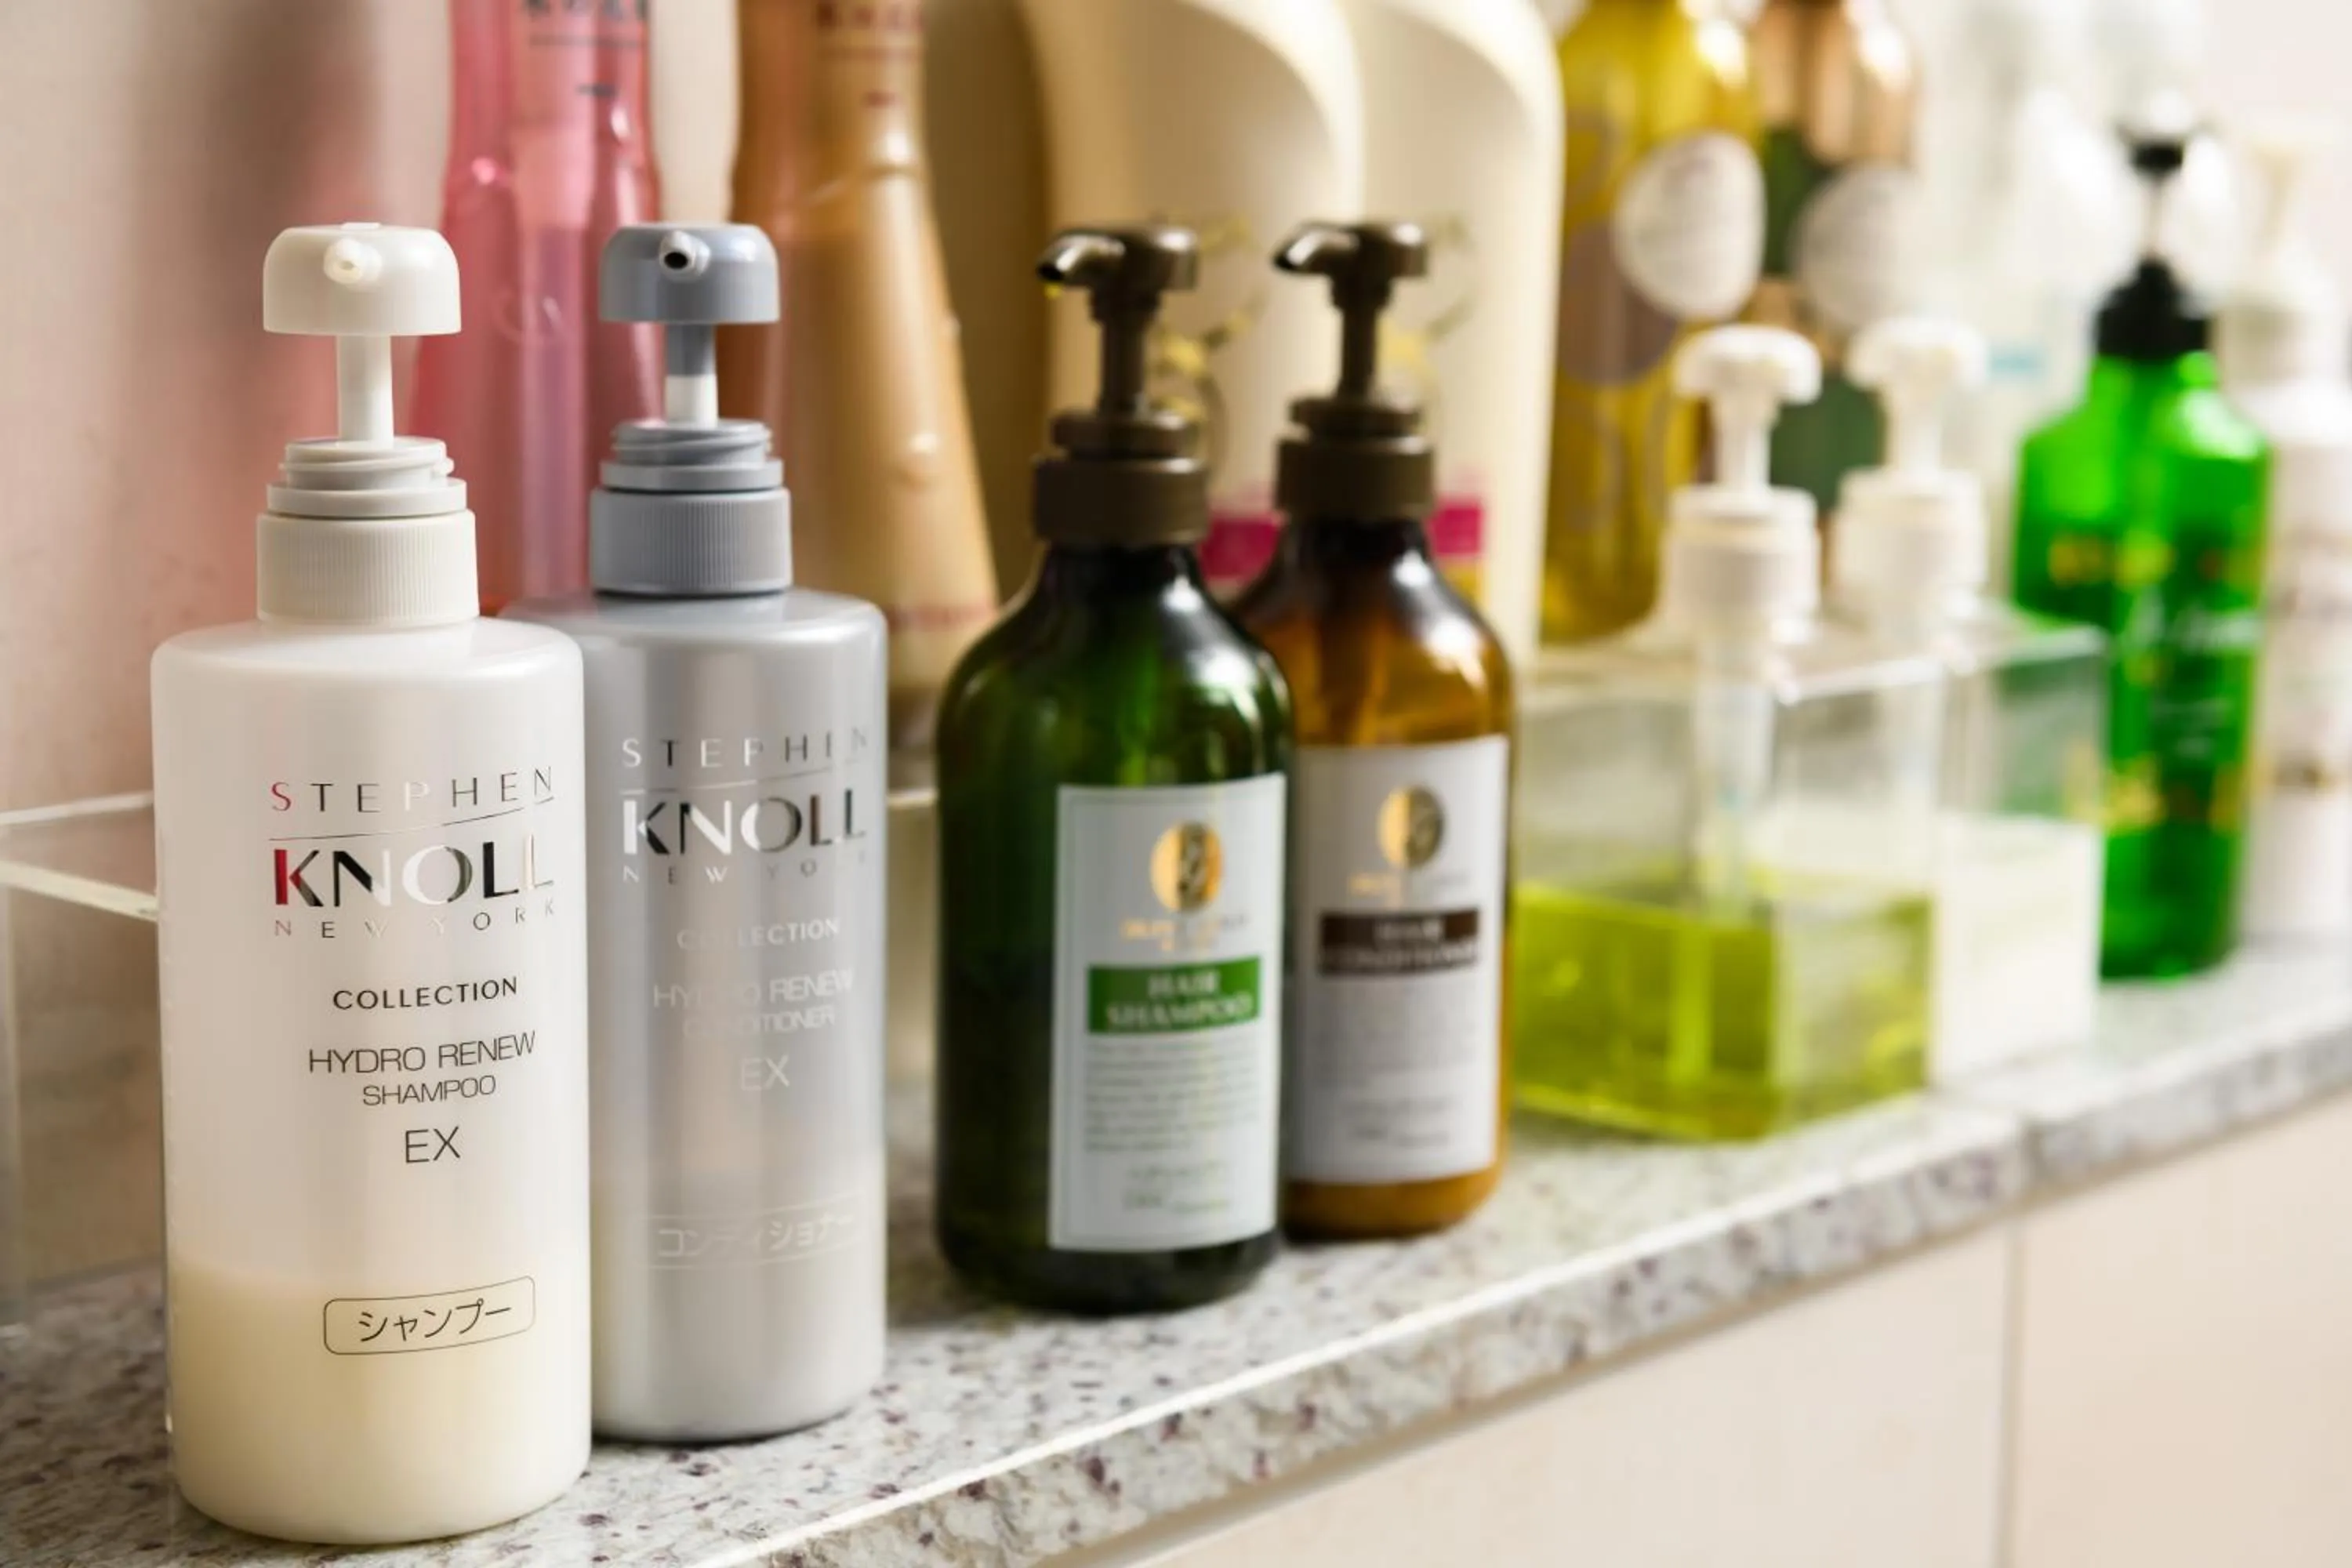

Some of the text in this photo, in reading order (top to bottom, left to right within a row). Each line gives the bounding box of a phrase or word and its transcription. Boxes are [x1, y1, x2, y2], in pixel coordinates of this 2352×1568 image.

[271, 765, 554, 813] STEPHEN
[623, 787, 866, 855] KNOLL
[274, 833, 554, 908] KNOLL
[622, 864, 729, 885] NEW
[274, 898, 554, 939] NEW YORK
[677, 916, 840, 950] CLECTION
[332, 976, 518, 1011] COLLECTION
[654, 967, 854, 1008] HYO RENEW
[1149, 971, 1220, 999] HAIR
[683, 1004, 835, 1039] CDITIONER
[1106, 993, 1253, 1026] SHAMPOO
[308, 1029, 536, 1074] HYDRO RENEW
[362, 1074, 497, 1106] SHAMPOO
[740, 1054, 789, 1091] EX
[404, 1125, 461, 1164] EX
[358, 1298, 512, 1341] シャンプー
